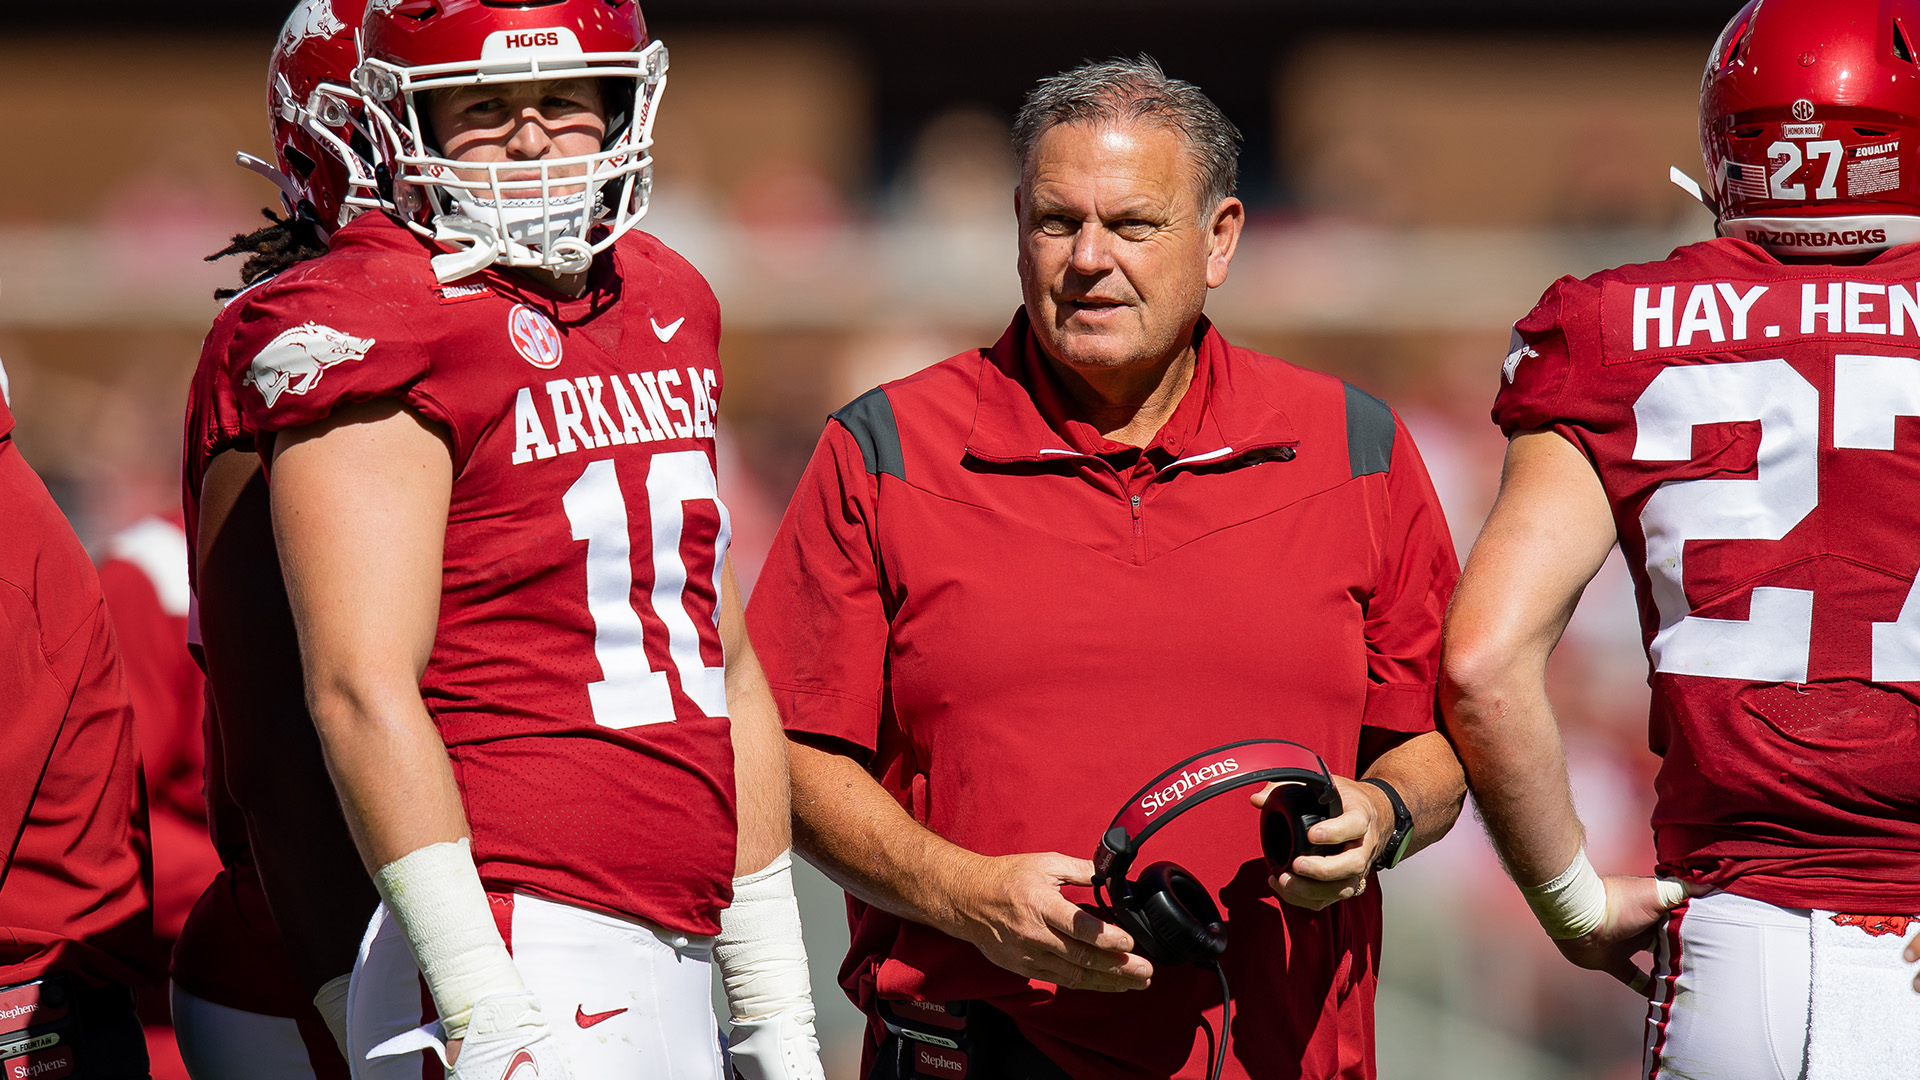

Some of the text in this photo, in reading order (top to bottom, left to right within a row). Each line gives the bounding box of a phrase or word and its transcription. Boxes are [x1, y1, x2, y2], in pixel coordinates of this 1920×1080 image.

[506, 32, 558, 48] HOGS
[1793, 101, 1813, 119] SEC
[1788, 126, 1816, 135] HONOR ROLL
[1856, 141, 1899, 157] EQUALITY
[1767, 140, 1844, 200] 27
[1745, 229, 1886, 247] RAZORBACKS
[1633, 283, 1780, 351] HAY.
[514, 308, 558, 363] SEC
[562, 450, 732, 730] 10
[1141, 757, 1239, 817] Stephens
[20, 1037, 52, 1052] FOUNTAIN
[14, 1058, 67, 1079] Stephens
[920, 1051, 962, 1072] Stephens
